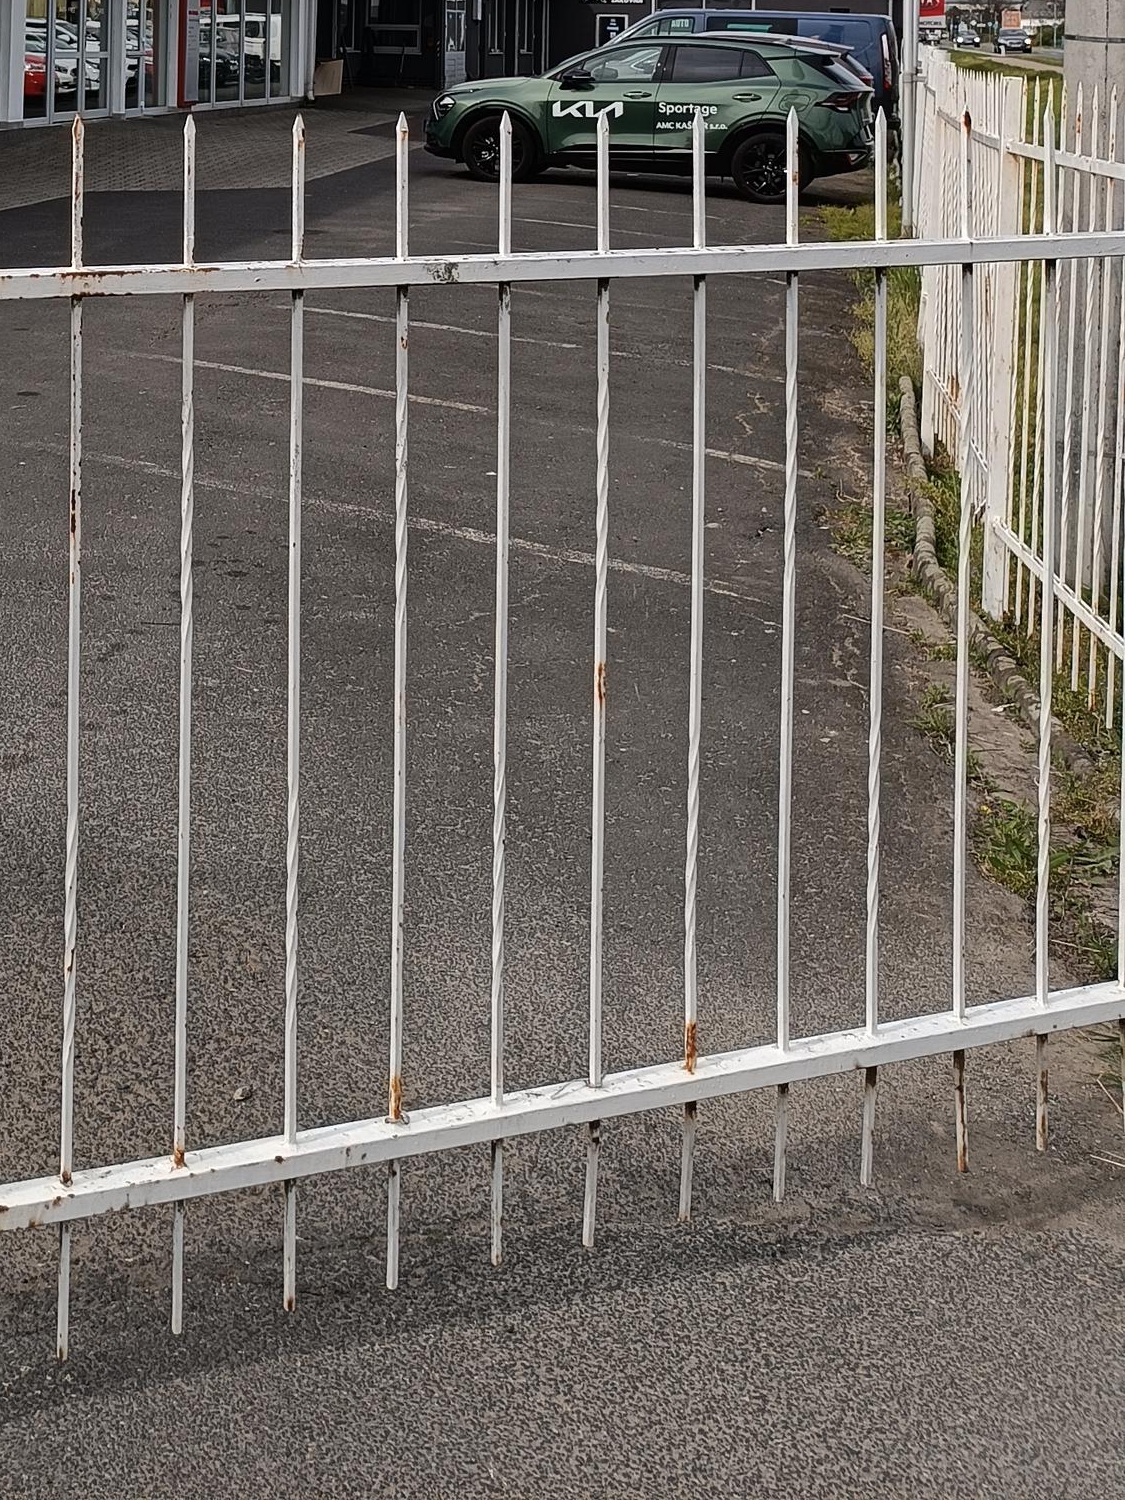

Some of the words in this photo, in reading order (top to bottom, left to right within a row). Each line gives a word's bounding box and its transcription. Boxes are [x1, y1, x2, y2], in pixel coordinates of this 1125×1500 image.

[671, 19, 689, 28] AUTO
[552, 100, 624, 118] KIA
[658, 102, 718, 117] Sportage
[656, 122, 675, 130] AMC
[676, 119, 708, 130] KAŠR
